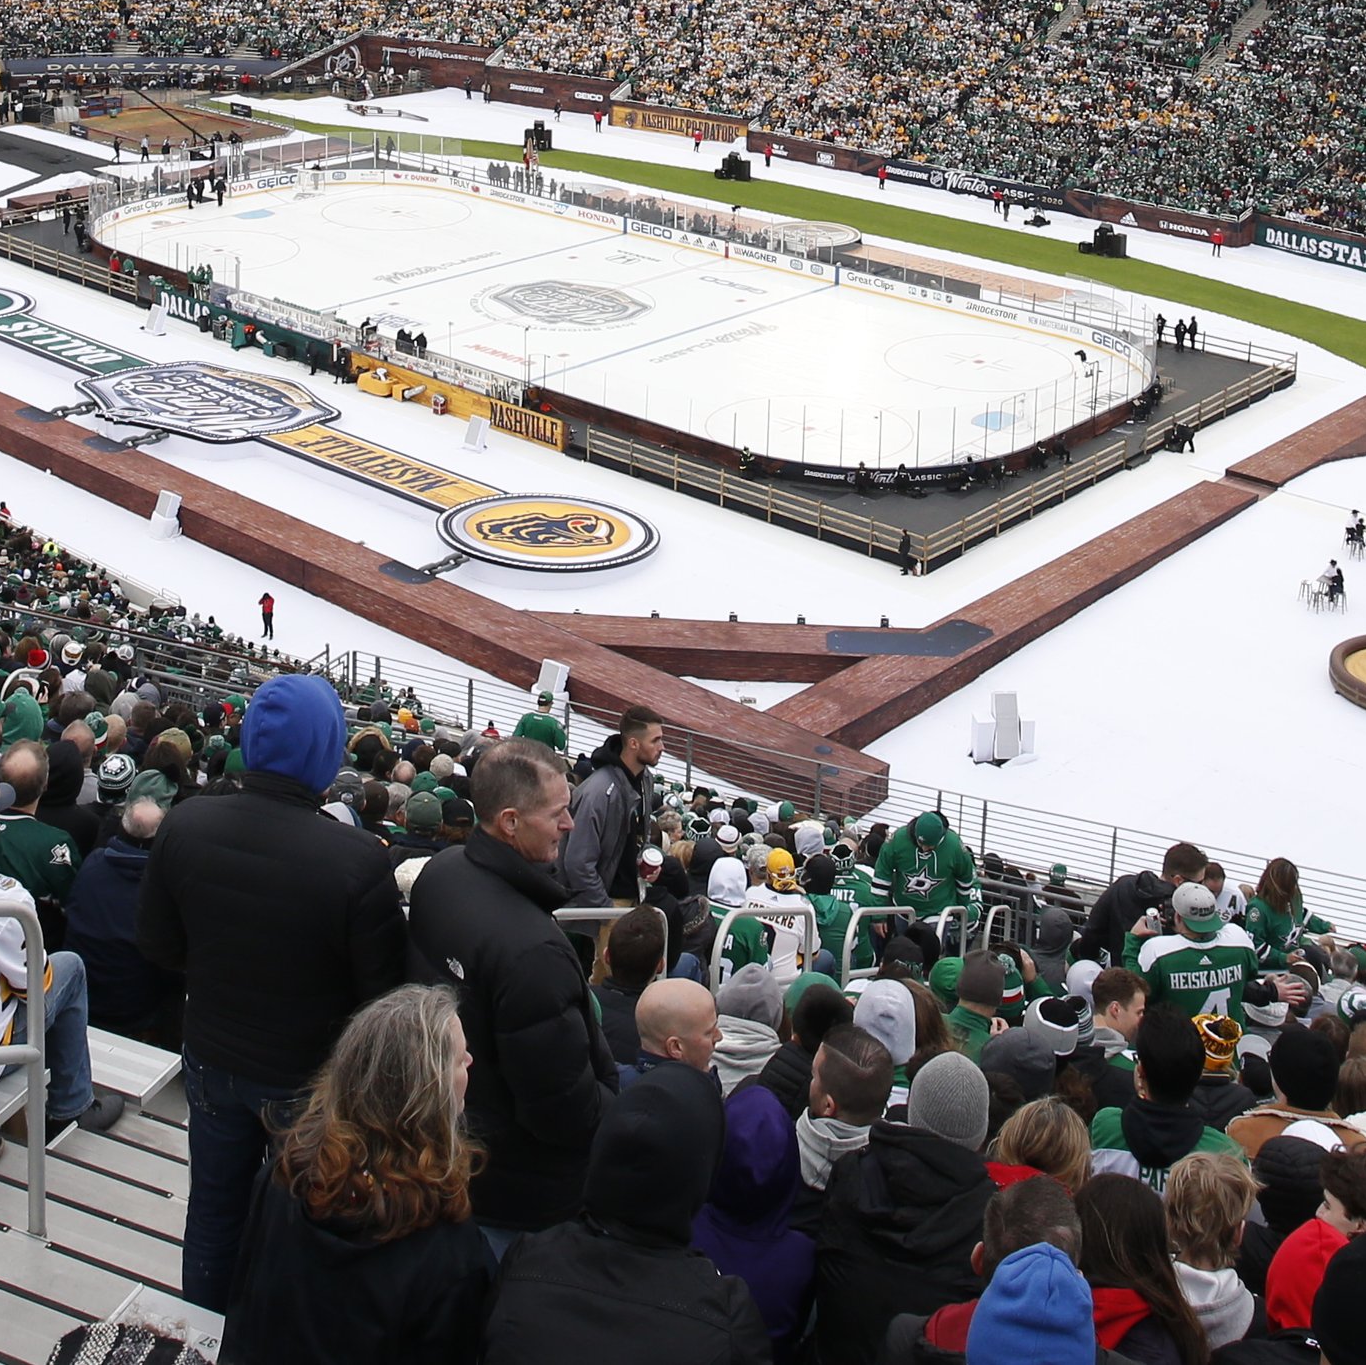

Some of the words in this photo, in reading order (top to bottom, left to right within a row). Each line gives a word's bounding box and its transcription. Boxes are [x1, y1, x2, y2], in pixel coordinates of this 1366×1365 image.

[416, 45, 444, 60] Winter
[442, 52, 469, 62] CLASSIC
[46, 63, 135, 71] DALLAS
[166, 63, 238, 72] TEXAS
[574, 91, 604, 103] GEICO
[640, 112, 686, 132] NASHVILLE
[230, 181, 254, 194] NDA
[256, 174, 298, 189] GEICO
[449, 177, 471, 191] TRULY
[885, 165, 929, 181] BRIDGESTONE
[944, 170, 991, 195] Winter
[1041, 196, 1063, 206] 2020
[490, 188, 526, 204] BRIDGESTONE
[123, 201, 144, 215] Great
[144, 199, 164, 211] Clips
[577, 209, 617, 226] HONDA
[630, 220, 673, 240] GEICO
[1168, 222, 1209, 237] HONDA
[1265, 227, 1319, 256] DALLAS
[741, 247, 778, 265] WAGNER
[846, 271, 873, 287] Great
[872, 277, 895, 291] Clips
[160, 291, 211, 323] DALLAS
[966, 301, 1019, 321] BRIDGESTONE
[1027, 315, 1038, 325] NEW
[1038, 318, 1069, 333] AMSTERDAM
[1091, 330, 1132, 359] GEICO
[169, 375, 273, 419] CLASSIC
[237, 381, 279, 398] 2020
[114, 373, 287, 437] Winter
[489, 401, 559, 448] NASHVILLE
[295, 435, 455, 494] NASHVILLE
[803, 469, 846, 481] BRIDGESTONE
[908, 472, 942, 482] LASSIC
[1169, 964, 1243, 990] HEISKANEN
[1199, 987, 1232, 1020] 4
